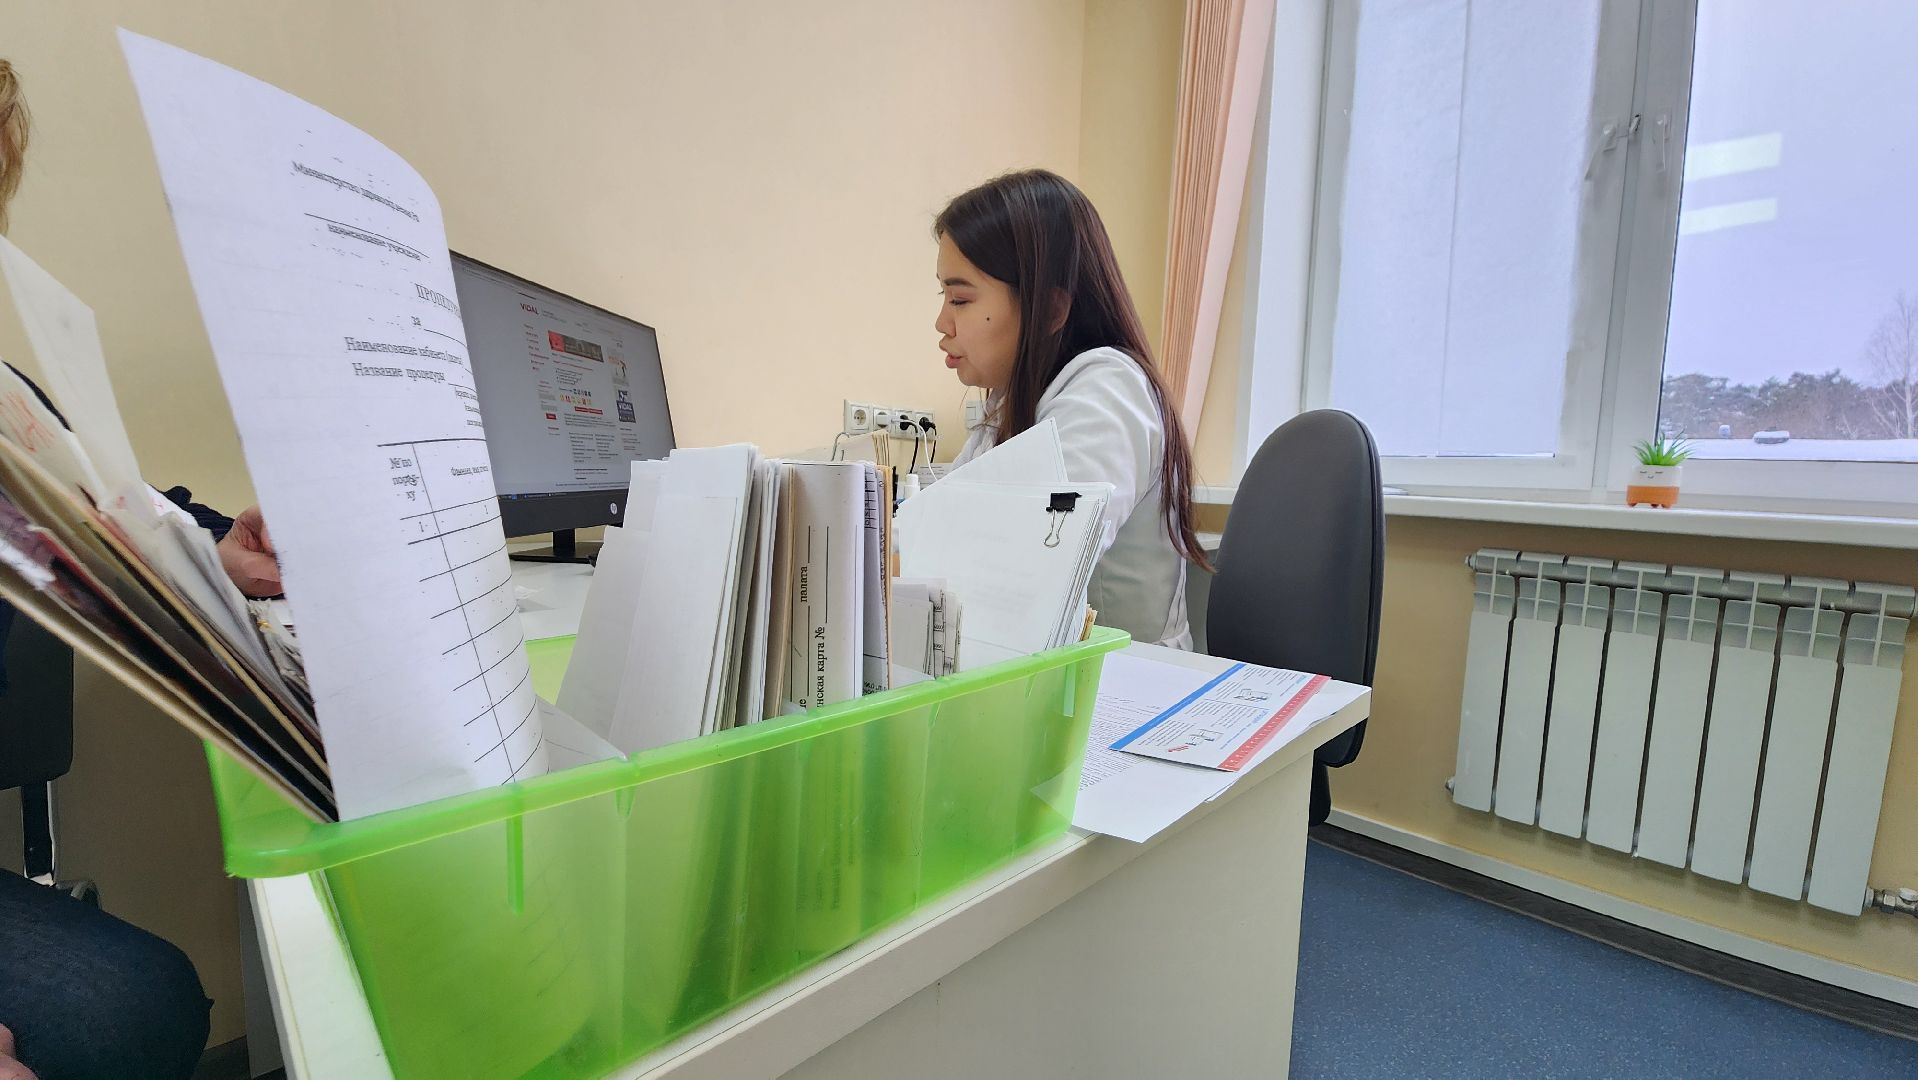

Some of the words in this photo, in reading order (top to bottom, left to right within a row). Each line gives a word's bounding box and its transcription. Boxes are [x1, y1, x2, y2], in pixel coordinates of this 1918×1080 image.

[352, 362, 403, 377] Название
[800, 565, 808, 603] палата
[814, 626, 825, 640] №
[817, 642, 828, 672] карта
